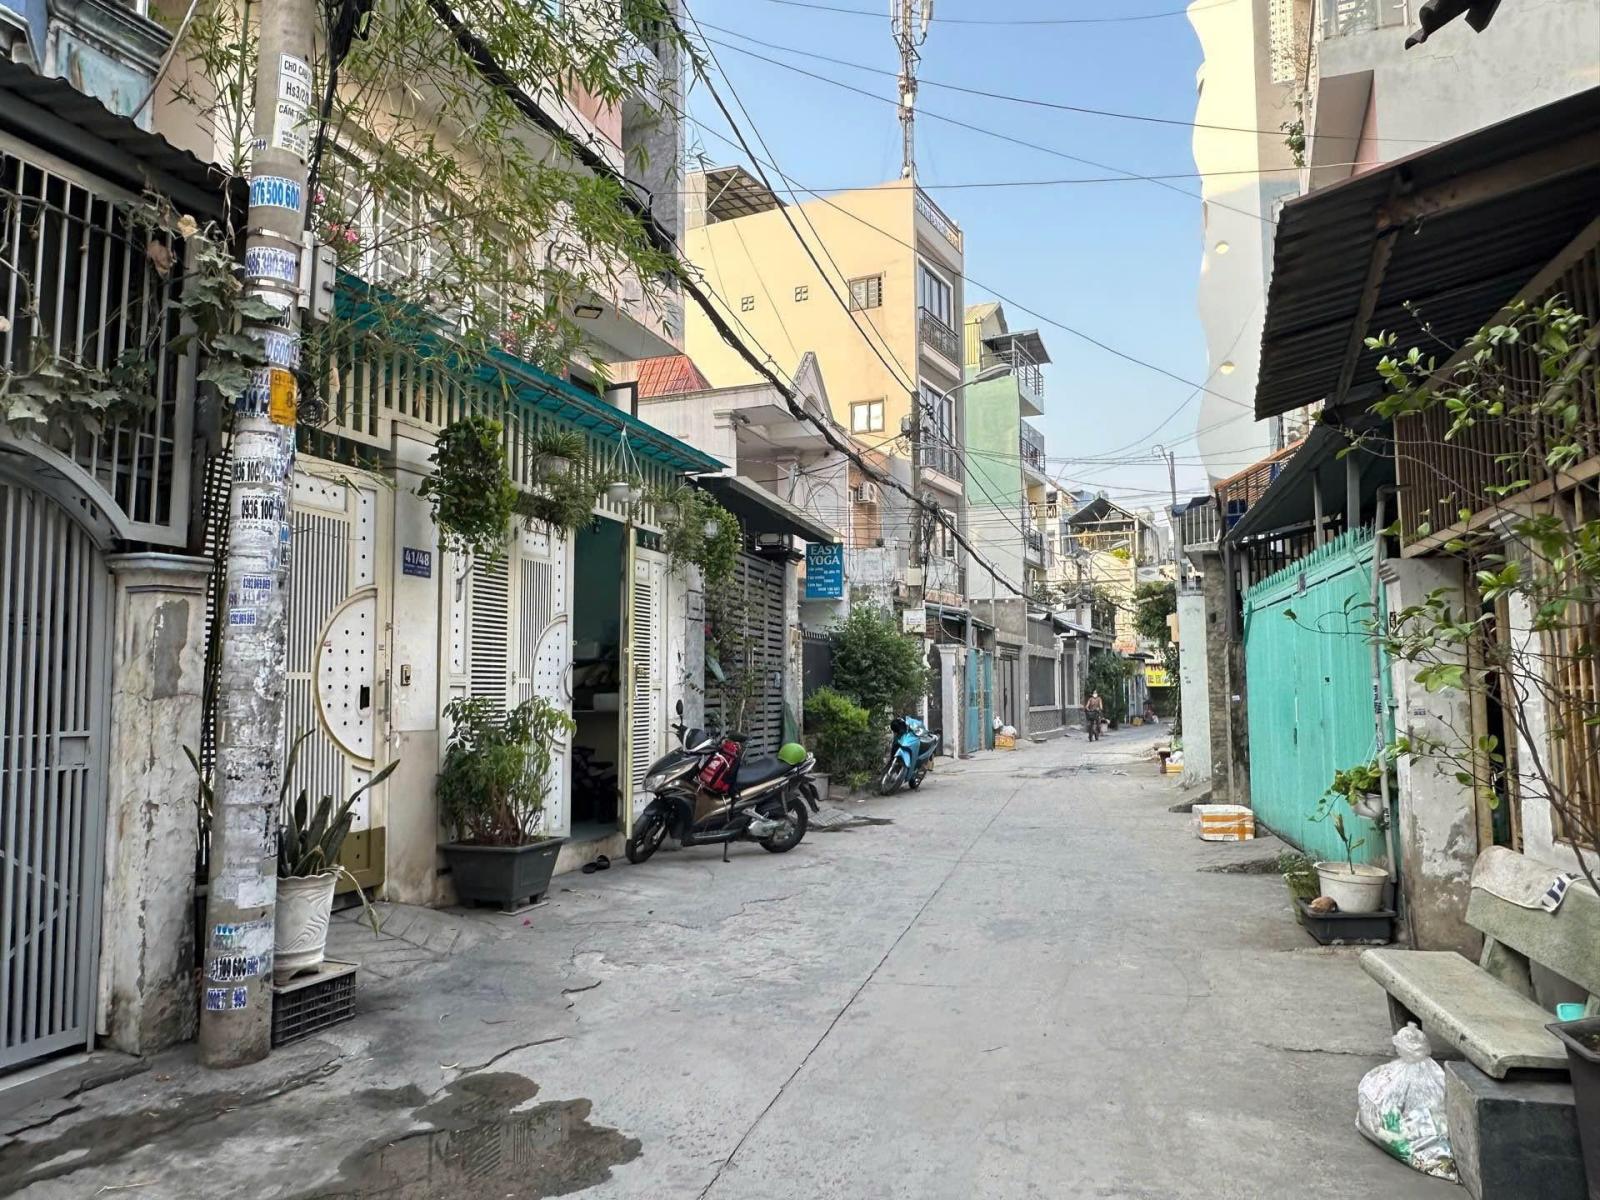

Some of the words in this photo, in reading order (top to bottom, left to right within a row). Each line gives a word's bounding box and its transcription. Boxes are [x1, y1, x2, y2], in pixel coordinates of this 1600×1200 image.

[811, 545, 839, 556] EASY
[405, 550, 430, 567] 41/48
[808, 555, 841, 566] YOGA
